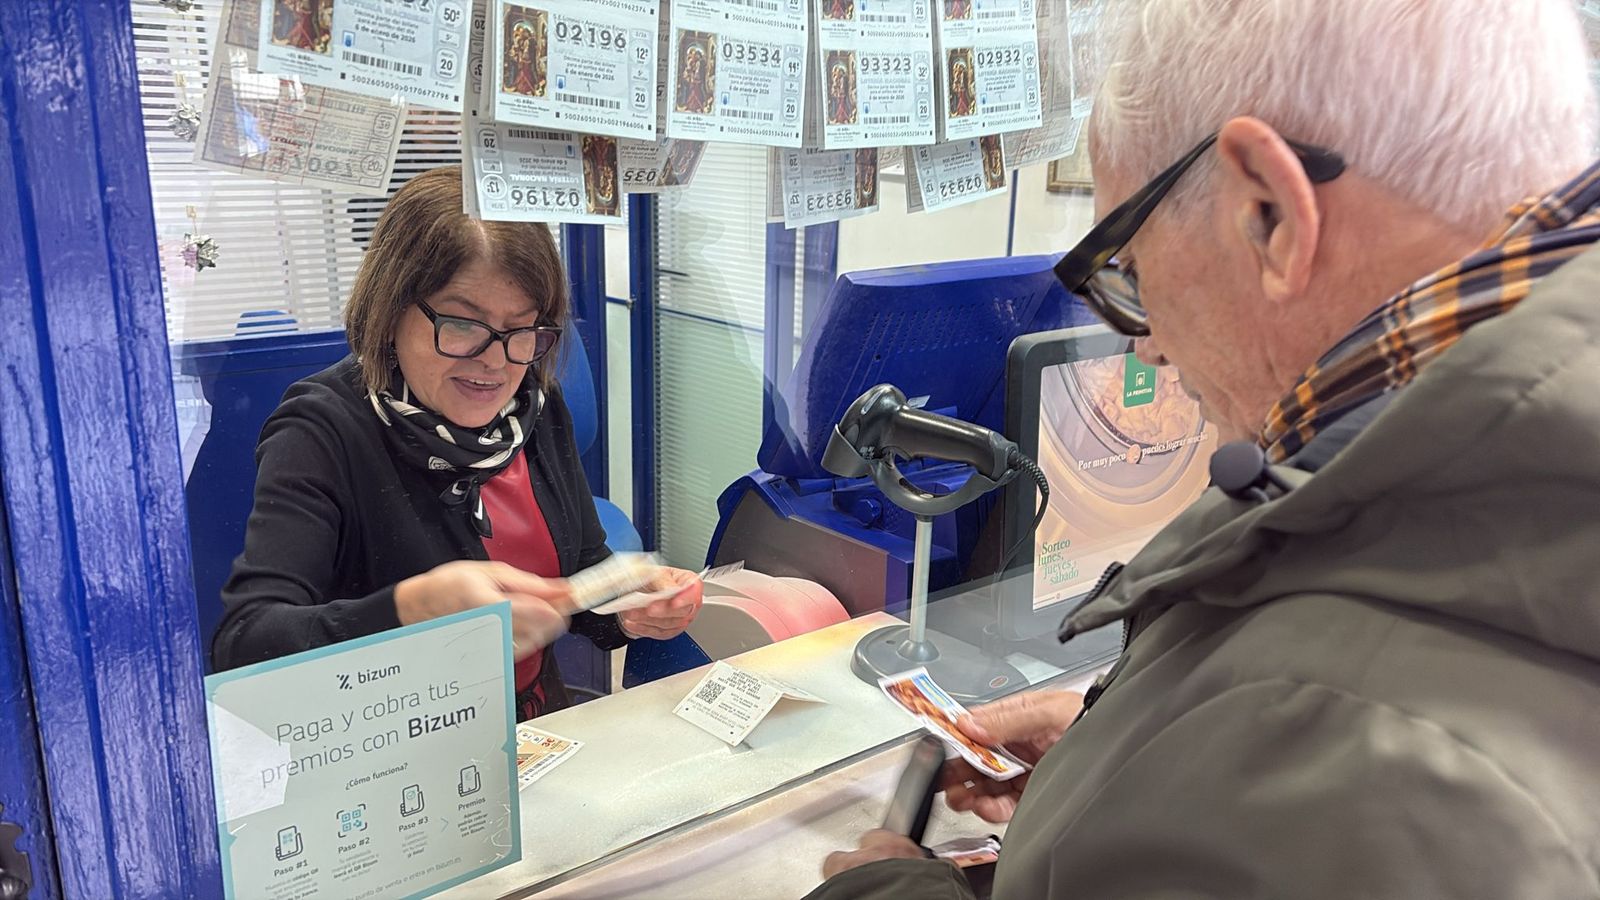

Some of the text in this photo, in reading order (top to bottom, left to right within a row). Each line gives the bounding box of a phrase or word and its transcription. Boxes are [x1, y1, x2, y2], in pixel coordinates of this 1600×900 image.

[916, 7, 923, 15] 20
[371, 29, 390, 37] enero
[391, 32, 399, 40] de
[556, 22, 626, 48] 02196
[723, 43, 781, 64] 03534
[978, 50, 1021, 65] 02932
[440, 59, 452, 70] 20
[861, 58, 911, 71] 93323
[636, 93, 646, 103] 20
[1029, 92, 1035, 100] 20
[787, 104, 795, 113] 20
[484, 138, 495, 148] 20
[790, 158, 798, 167] 20
[510, 174, 547, 182] NACIONAL
[624, 169, 656, 182] 035
[940, 177, 982, 197] 02932
[511, 189, 580, 206] 02196
[806, 193, 851, 210] 93323
[1078, 460, 1091, 470] Por
[1093, 458, 1107, 468] muy
[1109, 452, 1126, 466] poco
[1142, 446, 1165, 459] puedes
[1166, 440, 1187, 453] lograr
[1042, 540, 1071, 555] Sorteo
[358, 664, 400, 684] bizum
[276, 680, 460, 746] Paga y cobra tus
[261, 705, 476, 789] premios con Bizum
[346, 762, 408, 790] ¿Cómo funciona?
[459, 798, 486, 811] Premios
[399, 816, 428, 832] Paso #3
[338, 837, 370, 854] Paso #2
[274, 860, 308, 876] Paso #1
[409, 871, 425, 880] entra
